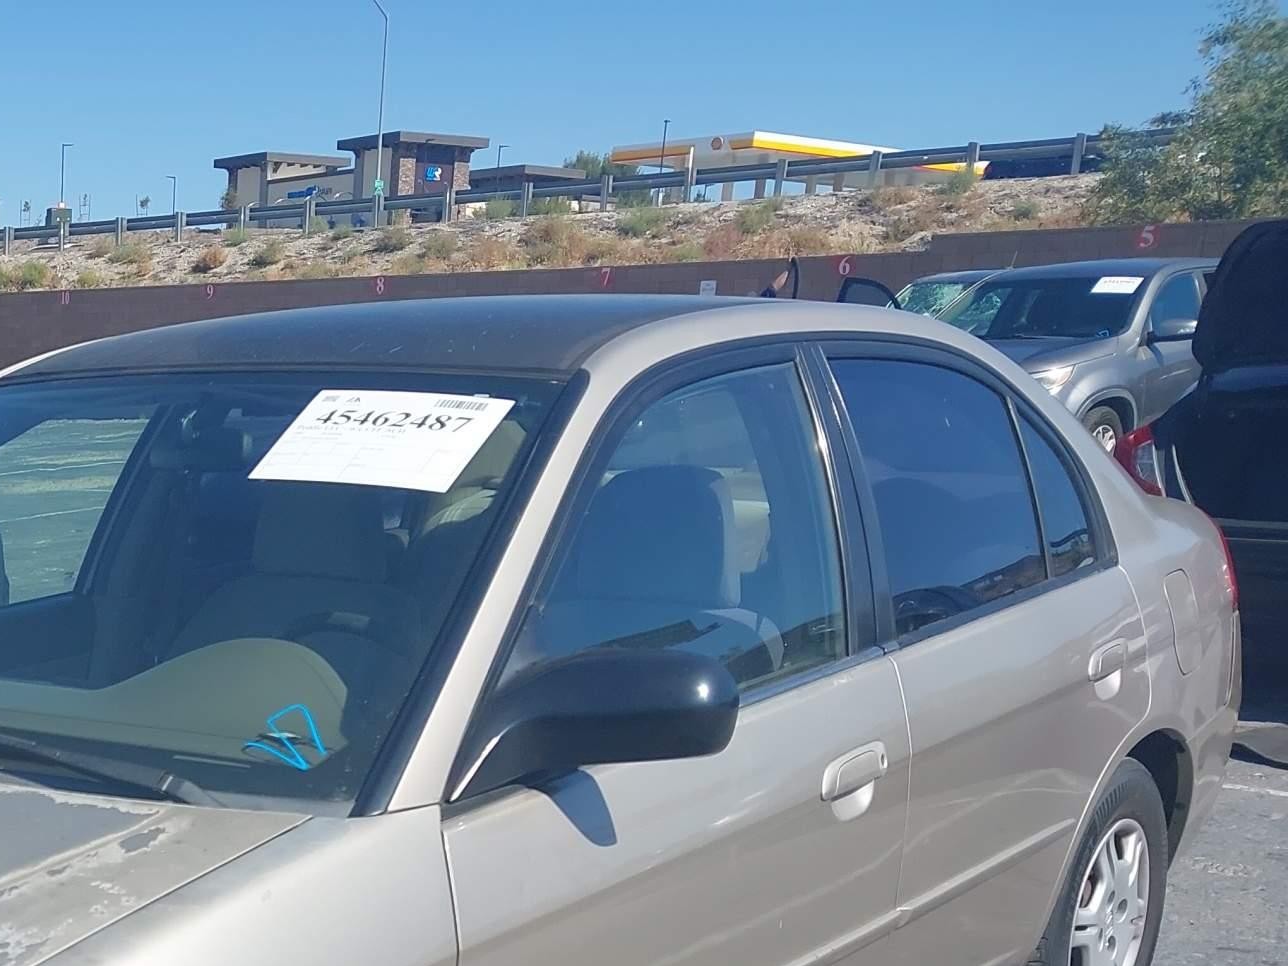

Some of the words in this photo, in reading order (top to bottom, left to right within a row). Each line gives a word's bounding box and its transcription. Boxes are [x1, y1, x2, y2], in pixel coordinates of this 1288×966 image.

[1139, 225, 1156, 247] 5
[839, 256, 852, 275] 6
[376, 277, 385, 295] 8
[600, 267, 610, 286] 7
[61, 290, 70, 304] 10
[206, 284, 214, 299] 9
[316, 409, 476, 432] 45462487
